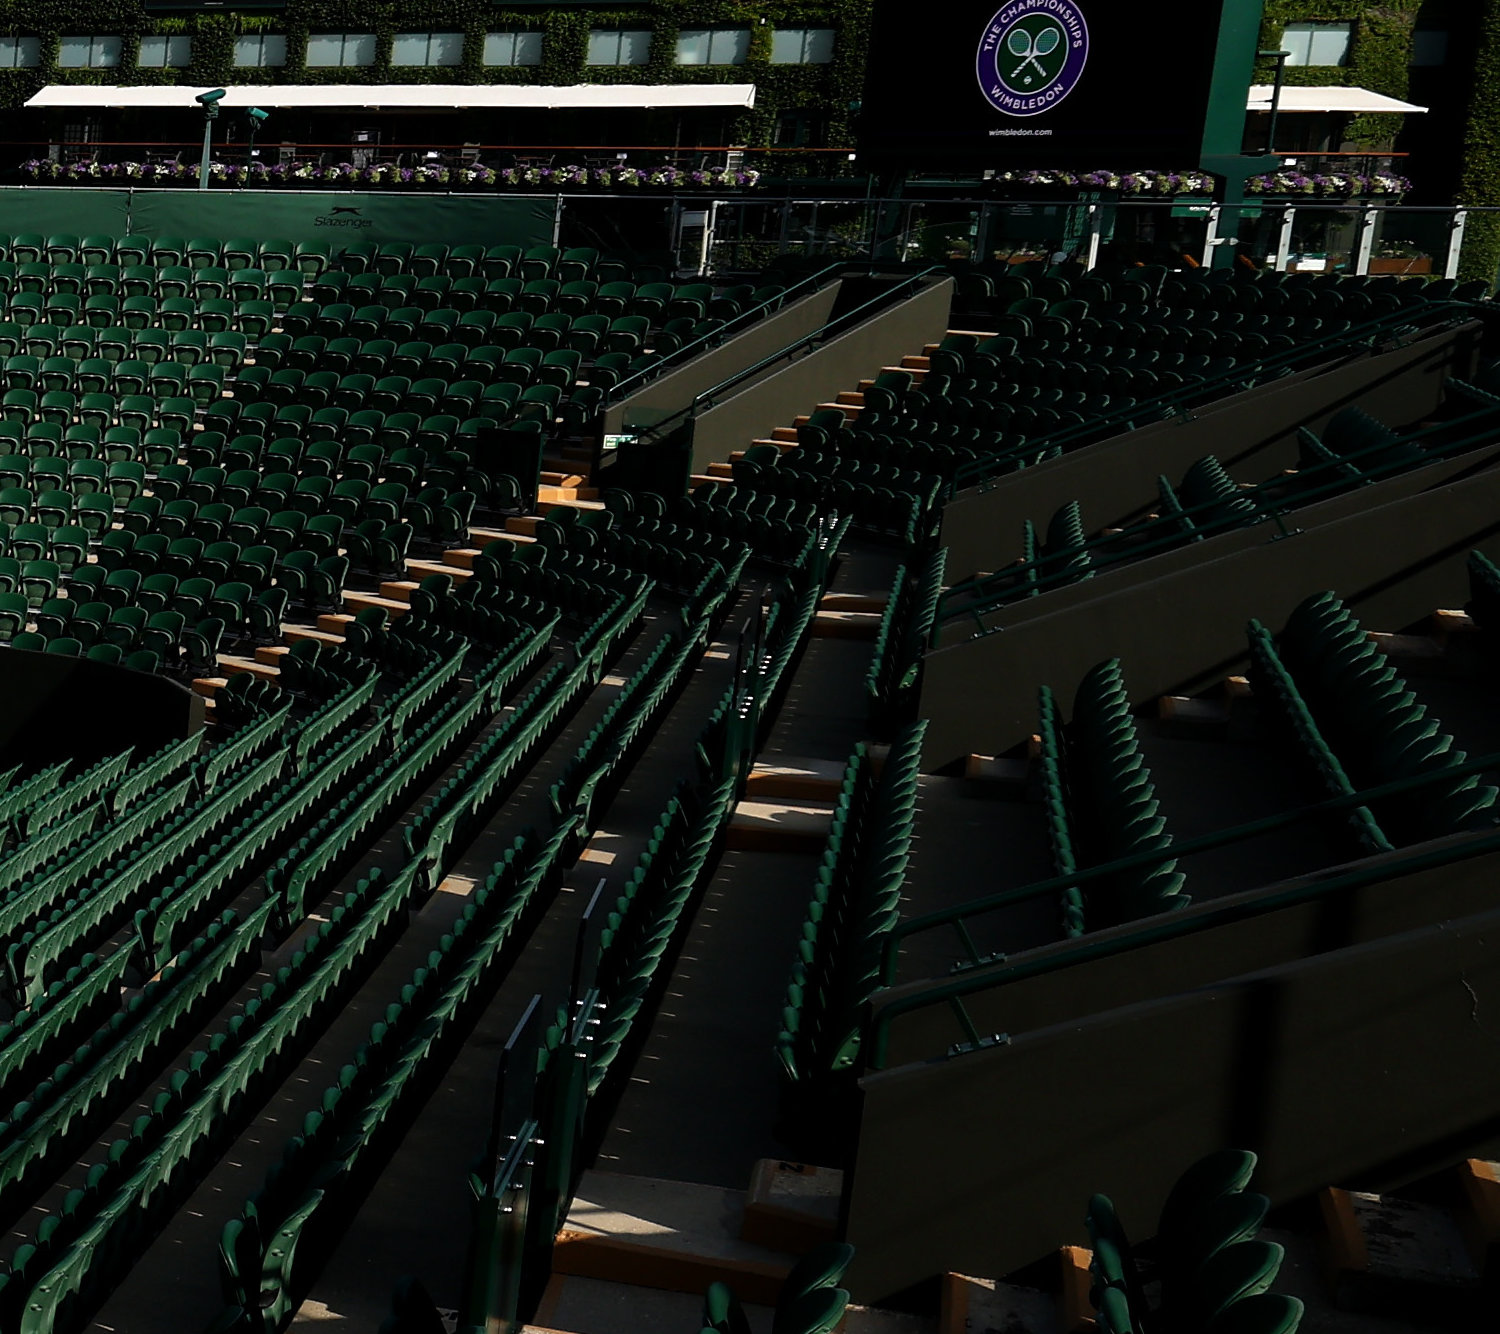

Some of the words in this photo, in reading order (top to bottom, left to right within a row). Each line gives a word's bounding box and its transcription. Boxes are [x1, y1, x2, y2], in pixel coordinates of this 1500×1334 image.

[983, 24, 1002, 51] THE
[991, 84, 1064, 110] WIMBLEDON
[988, 128, 1053, 136] wimbledon.com
[314, 217, 372, 229] Slazenger
